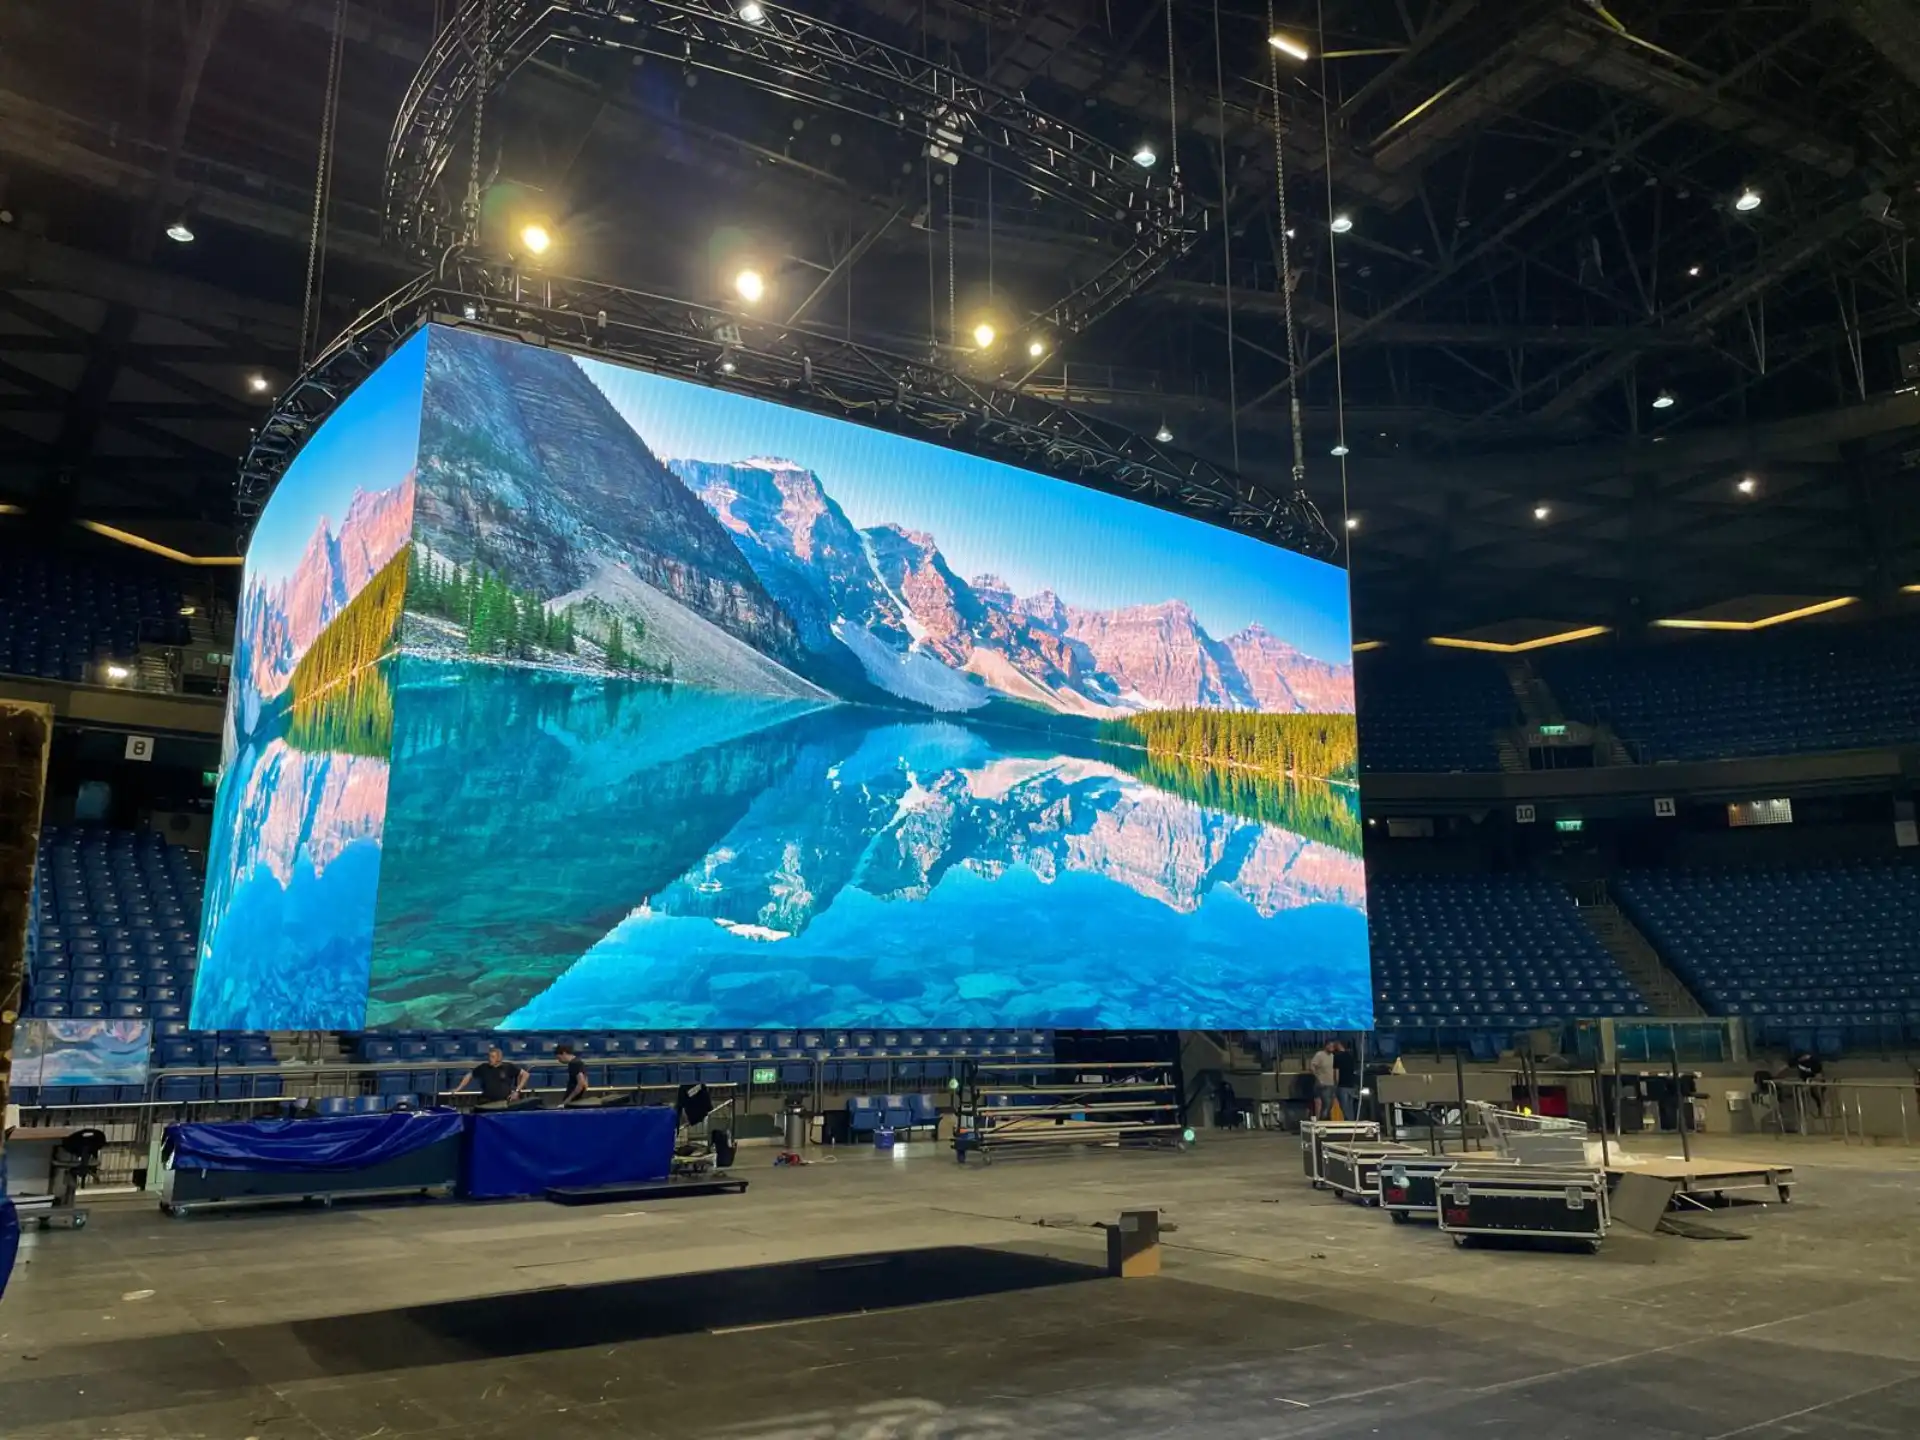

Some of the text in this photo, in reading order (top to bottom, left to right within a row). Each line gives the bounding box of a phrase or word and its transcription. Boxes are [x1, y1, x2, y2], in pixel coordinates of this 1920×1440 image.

[133, 741, 146, 755] 8
[1658, 801, 1672, 813] 11
[1518, 808, 1533, 820] 10
